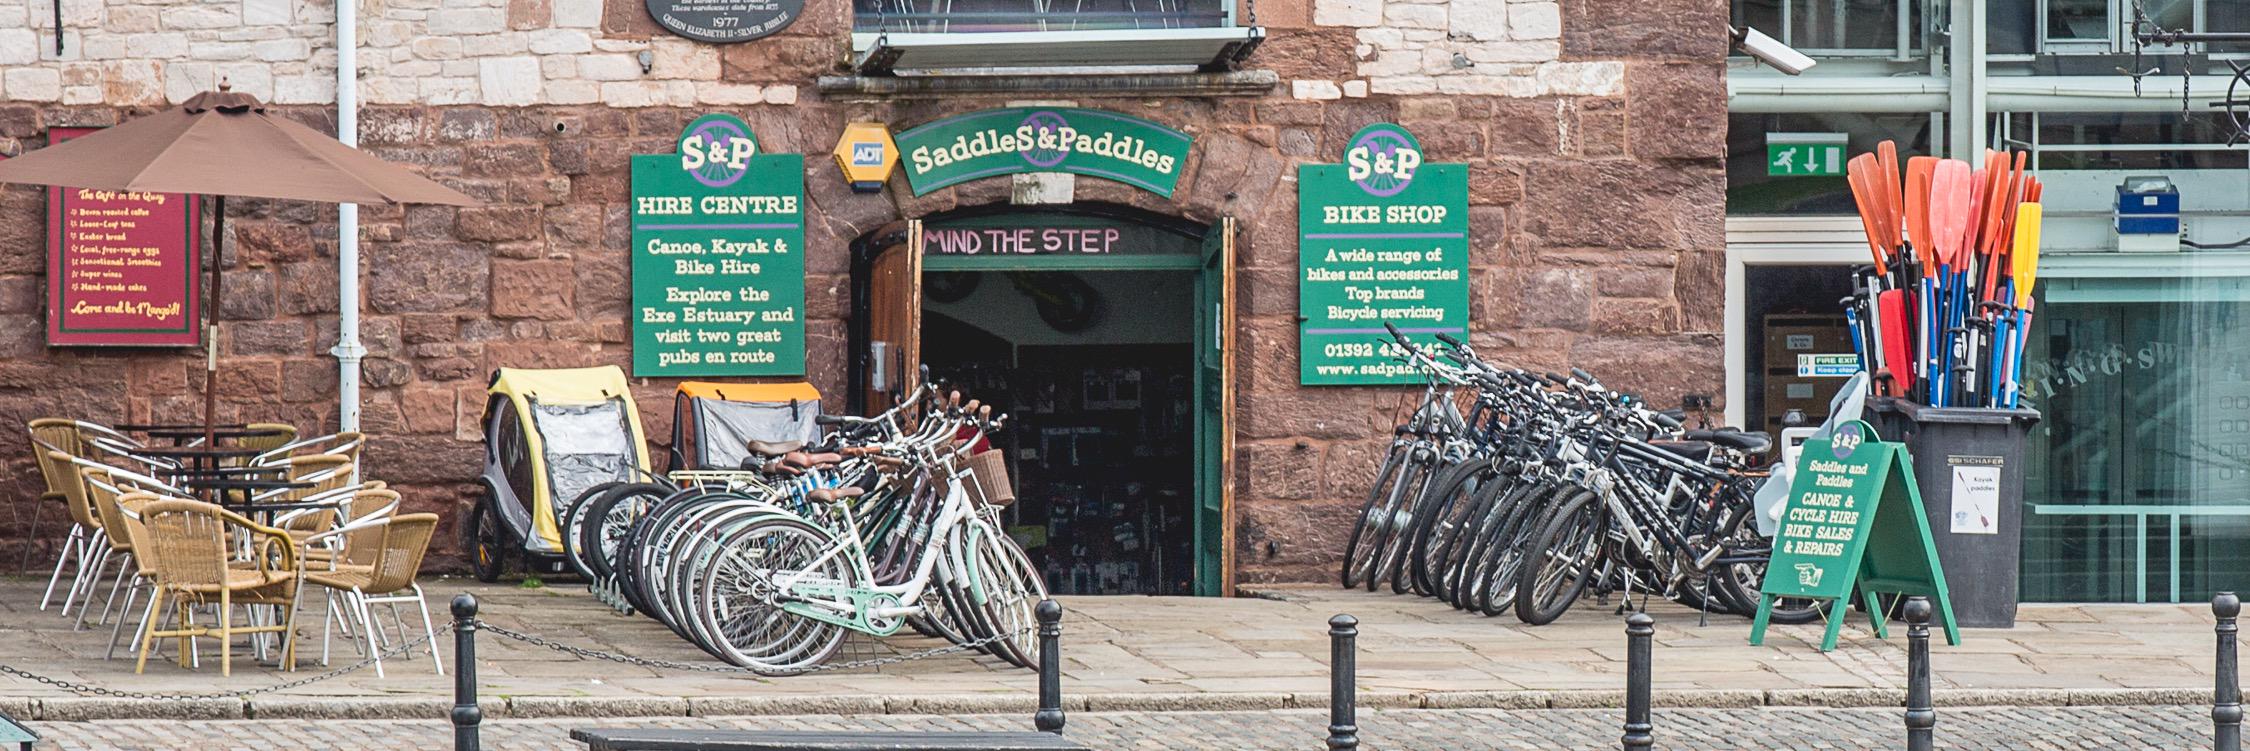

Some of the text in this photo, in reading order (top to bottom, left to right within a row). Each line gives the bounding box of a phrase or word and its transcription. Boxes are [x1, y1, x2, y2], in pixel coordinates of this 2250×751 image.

[663, 13, 687, 31] QUEEN
[687, 24, 725, 38] ELIZABETH
[738, 25, 763, 36] SILVER
[764, 11, 789, 31] JUBILEE
[712, 17, 739, 27] 1977
[682, 134, 755, 171] S&P
[854, 145, 883, 164] ADT
[1347, 146, 1421, 182] S&P
[118, 192, 127, 200] on
[128, 191, 141, 200] the
[142, 191, 165, 205] Quay
[637, 195, 797, 215] HIRE CENTRE
[103, 207, 129, 216] roasted
[1323, 205, 1447, 224] BIKE SHOP
[647, 238, 788, 256] Canoe, Kayak &
[923, 228, 1120, 254] MIND THE STEP
[142, 247, 160, 256] eggs
[1325, 248, 1443, 265] A wide range of
[675, 259, 760, 275] Bike Hire
[1307, 268, 1459, 282] bikes and accessories
[666, 287, 770, 305] Explore the
[1345, 286, 1425, 302] Top brands
[104, 300, 124, 314] and
[124, 301, 136, 314] be
[1327, 305, 1444, 322] Bicycle servicing
[642, 307, 794, 325] Exe Estuary and
[655, 328, 782, 346] visit two great
[658, 348, 775, 367] pubs en route
[1325, 343, 1373, 358] 01392
[1816, 356, 1857, 364] FIRE EXIT
[1832, 432, 1860, 450] S&P
[1809, 460, 1868, 475] Saddles and
[1816, 474, 1854, 488] Paddles
[1802, 492, 1855, 508] CANOE &
[1790, 507, 1859, 525] CYCLE HIRE
[1784, 523, 1854, 541] BIKE SALES
[1784, 540, 1844, 557] & REPAIRS
